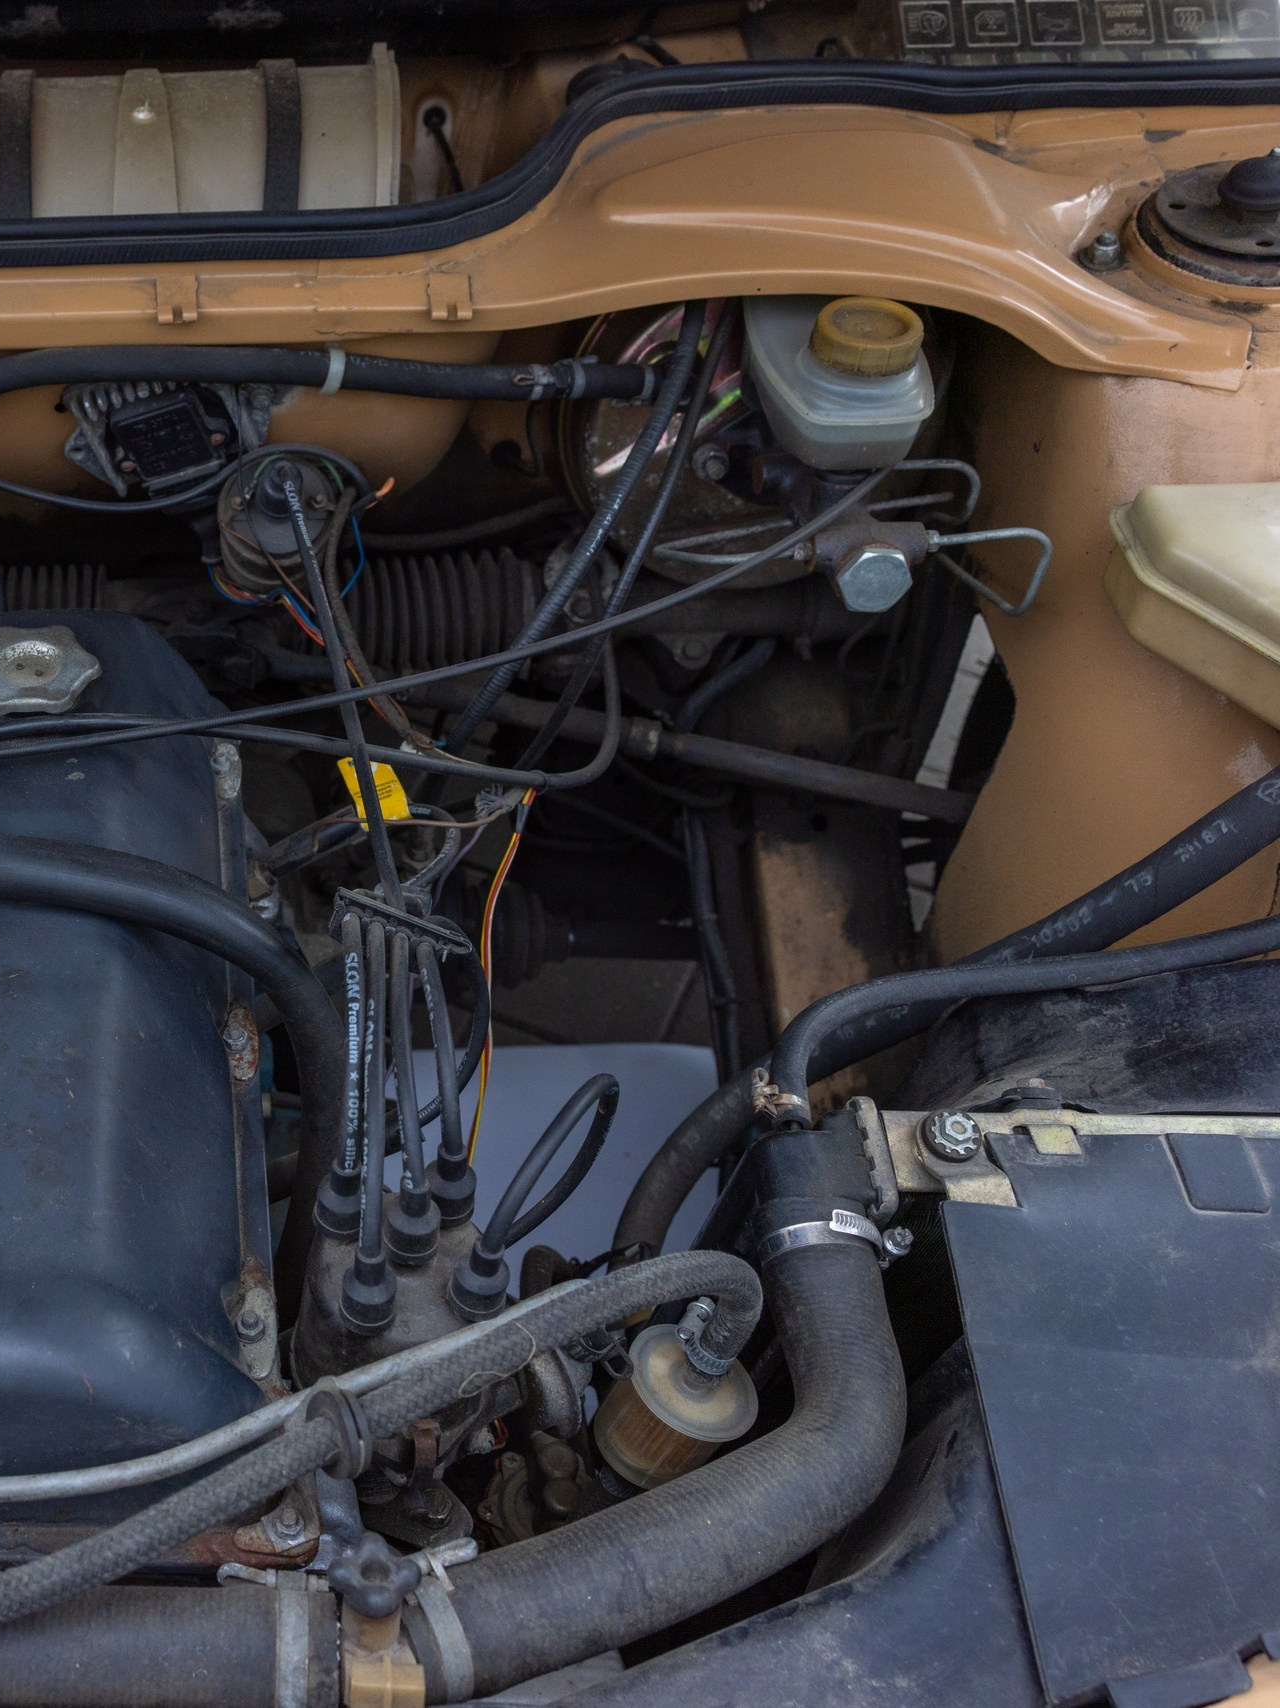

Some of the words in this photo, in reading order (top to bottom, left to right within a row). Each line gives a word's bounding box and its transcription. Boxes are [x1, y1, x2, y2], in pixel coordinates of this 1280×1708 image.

[283, 480, 301, 511] SLON
[296, 512, 312, 547] Premium
[345, 952, 360, 999] SLON
[348, 1002, 360, 1064] Premium
[346, 1089, 360, 1134] 100%
